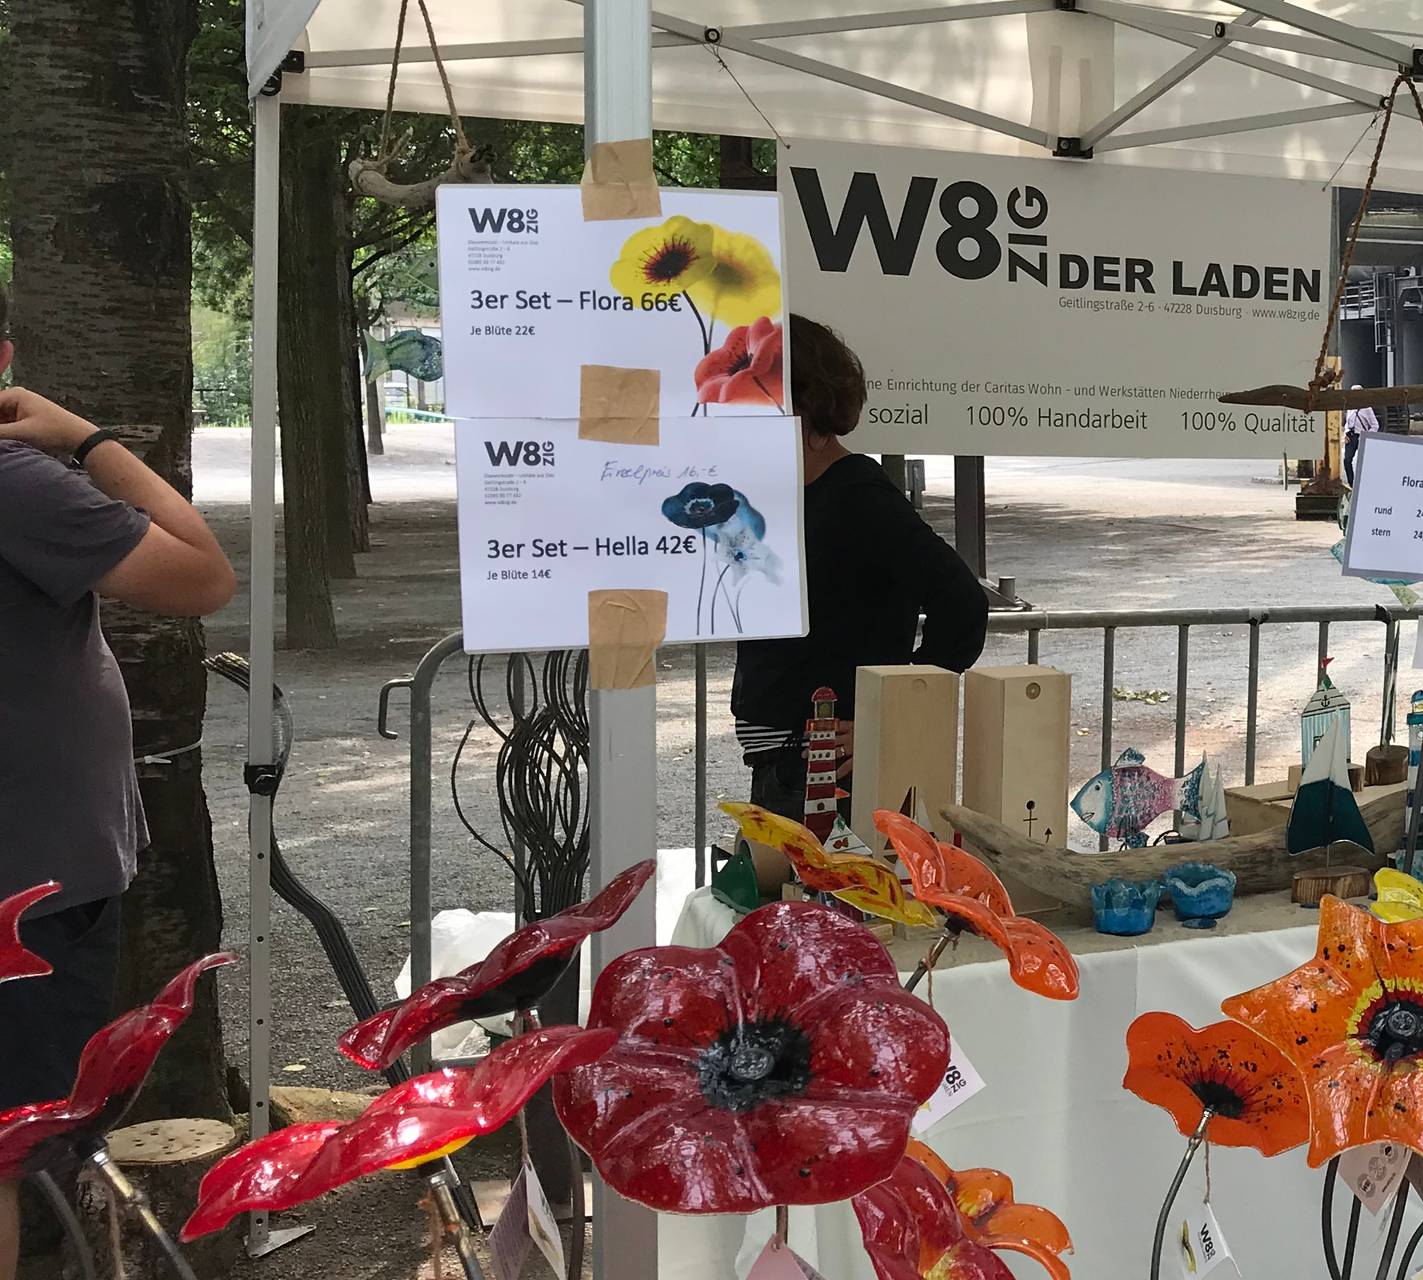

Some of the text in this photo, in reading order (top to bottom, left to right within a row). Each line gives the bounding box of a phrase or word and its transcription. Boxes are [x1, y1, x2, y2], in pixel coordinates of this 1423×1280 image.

[468, 207, 539, 234] W8 ZIG
[789, 166, 1049, 288] W8 ZIG
[1058, 253, 1322, 303] DER LADEN
[470, 289, 508, 310] 3er
[515, 289, 552, 310] Set
[579, 289, 634, 311] Flora
[640, 290, 682, 313] 66€
[1058, 296, 1320, 322] Geitlingstraße 2-6 47228 Duisburg www.w8zig.de
[470, 325, 536, 336] Je Blüte 22€
[887, 378, 958, 395] Einrichtung
[960, 380, 981, 393] der
[984, 381, 1026, 395] Caritas
[1028, 383, 1062, 396] Wohn
[1074, 384, 1097, 397] und
[1098, 385, 1166, 399] Werkstätten
[868, 403, 1316, 435] sozial 100% Handarbeit 100% Qualität
[484, 440, 555, 466] W8 ZIG
[1374, 506, 1393, 516] rund
[1371, 527, 1391, 537] stern
[488, 538, 526, 559] 3er
[531, 538, 568, 558] Set
[595, 535, 649, 557] Hella
[655, 534, 698, 555] 42€
[487, 568, 552, 581] Je Blüte 14€
[950, 1079, 967, 1094] ZIG
